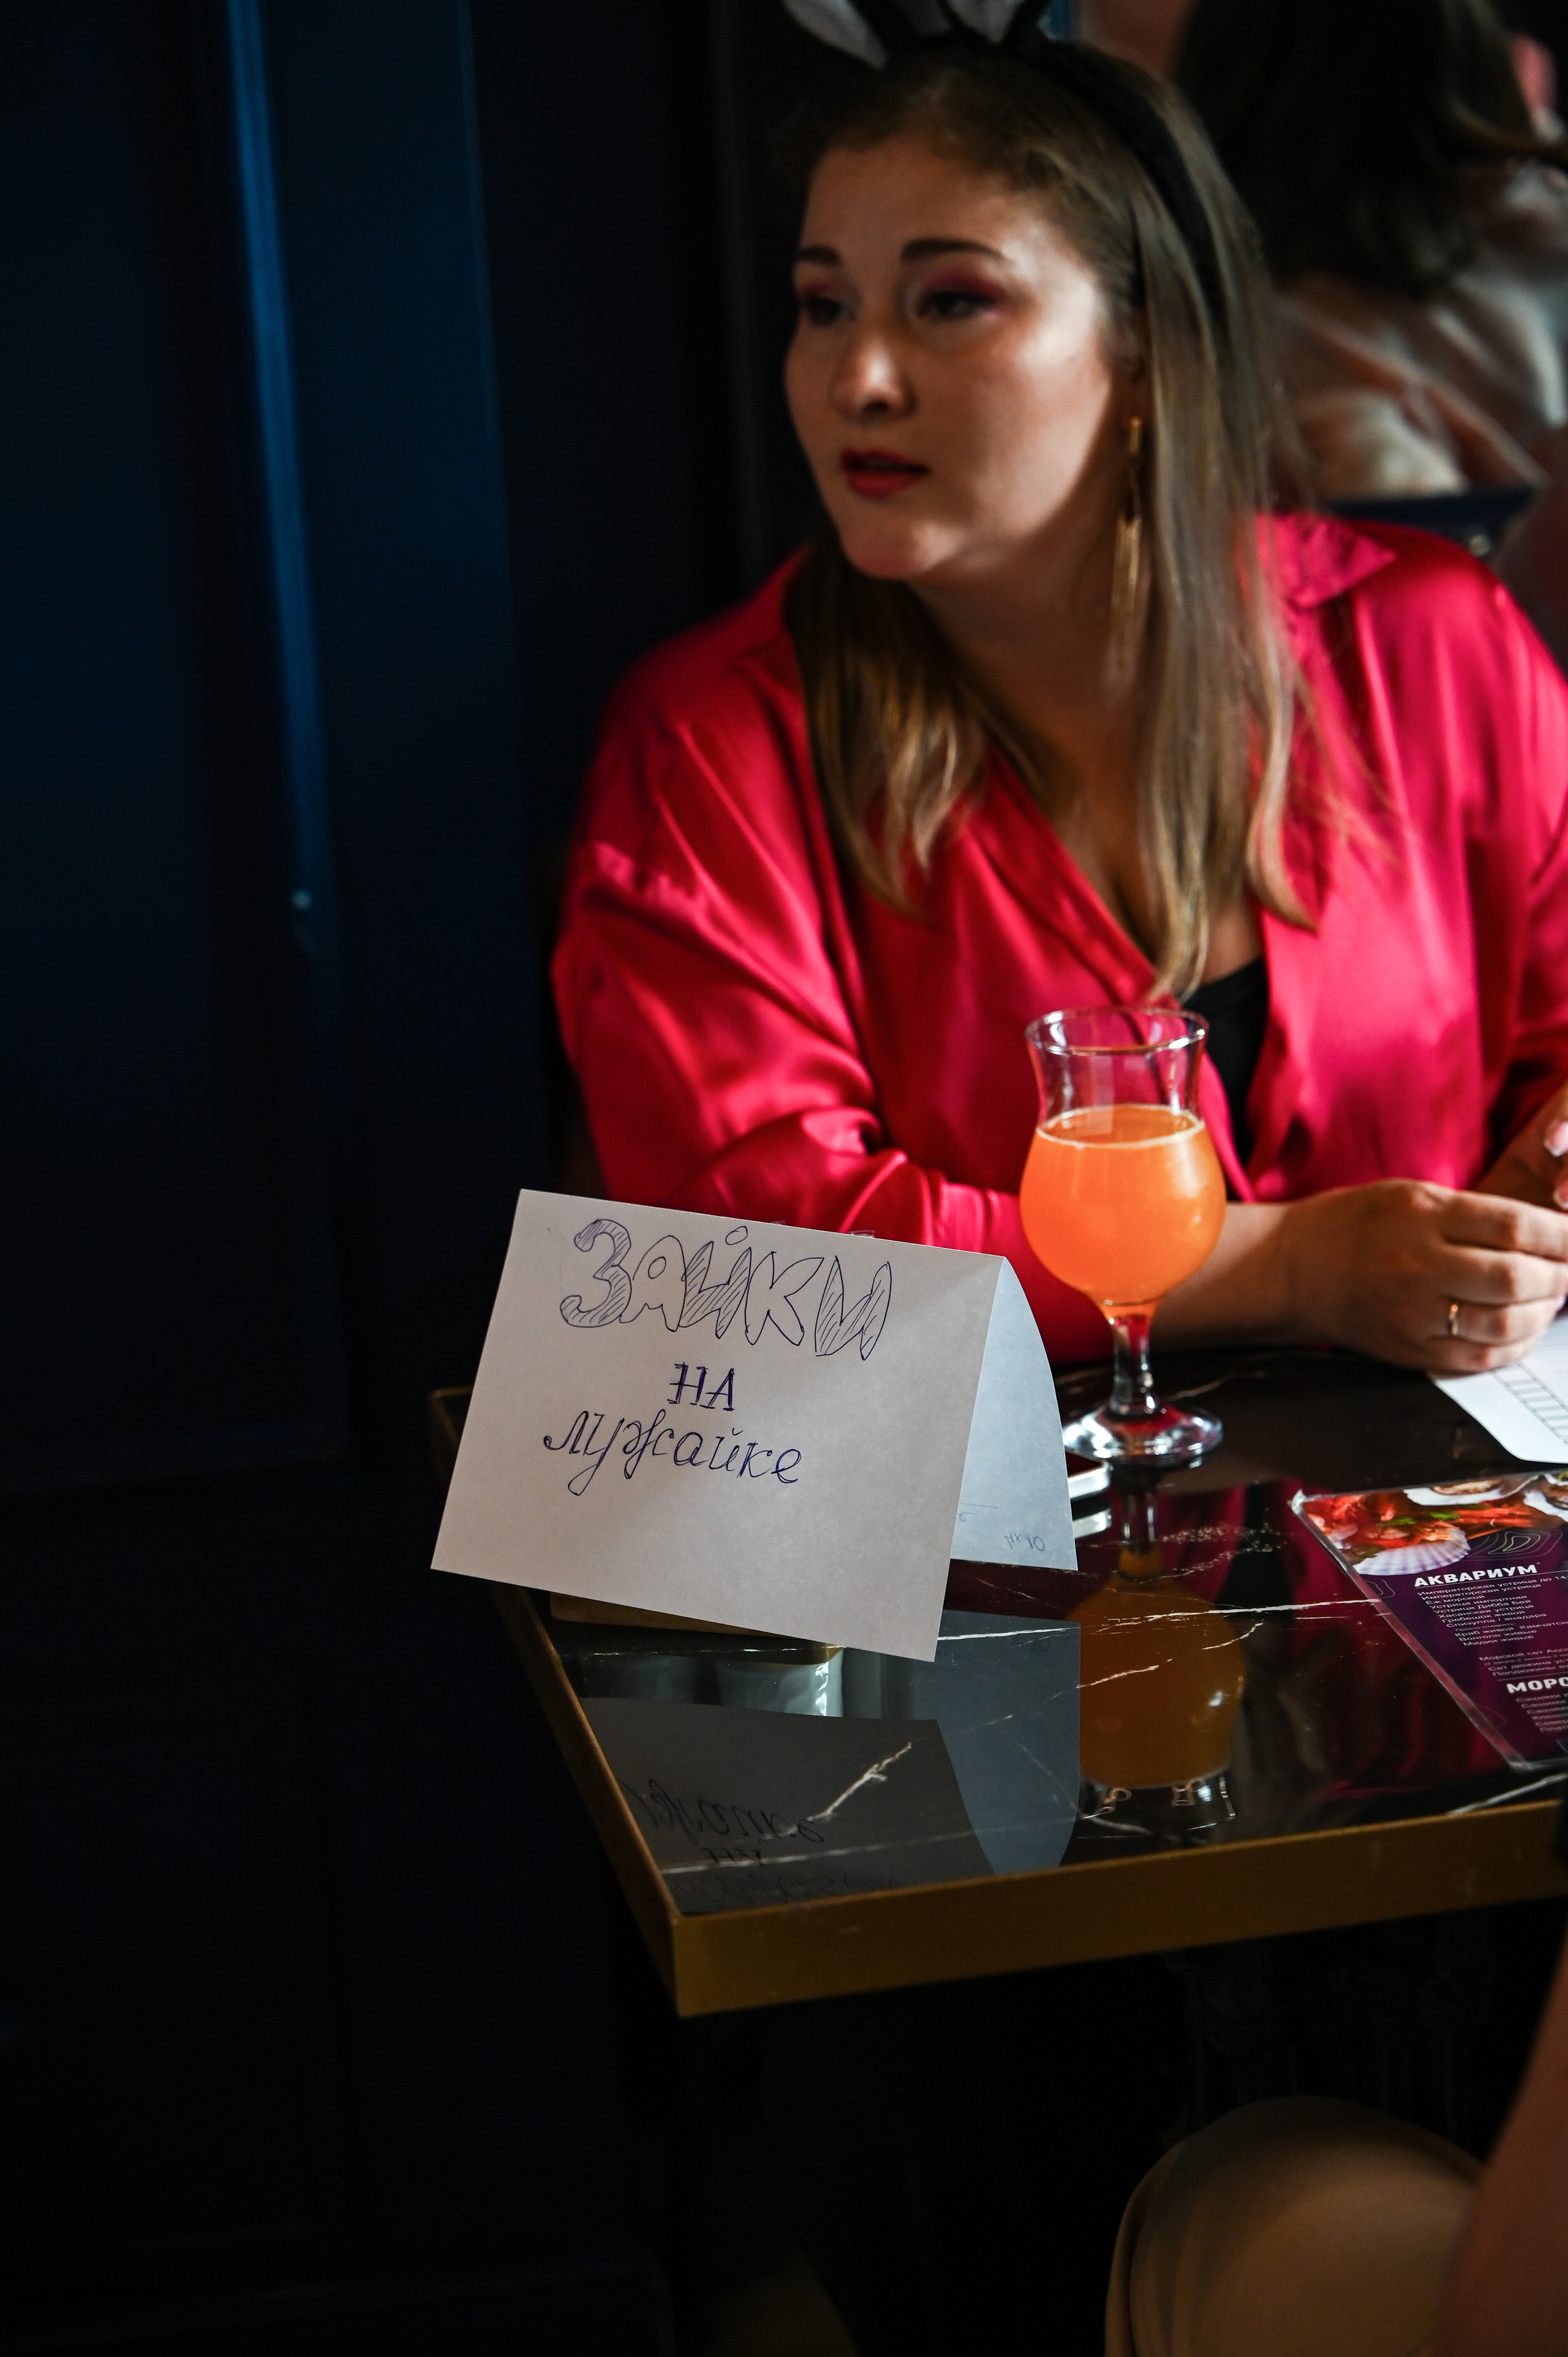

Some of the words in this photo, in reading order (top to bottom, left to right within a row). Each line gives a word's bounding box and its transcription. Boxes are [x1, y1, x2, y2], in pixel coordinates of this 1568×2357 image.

[560, 1219, 892, 1360] ЗАЙКИ
[668, 1362, 736, 1411] НА
[1414, 1564, 1537, 1587] АКВАРИУМ
[1417, 1584, 1495, 1595] Императорская
[1422, 1589, 1499, 1600] Императорская
[1473, 1595, 1528, 1604] импортная
[1442, 1614, 1492, 1623] Гребешок
